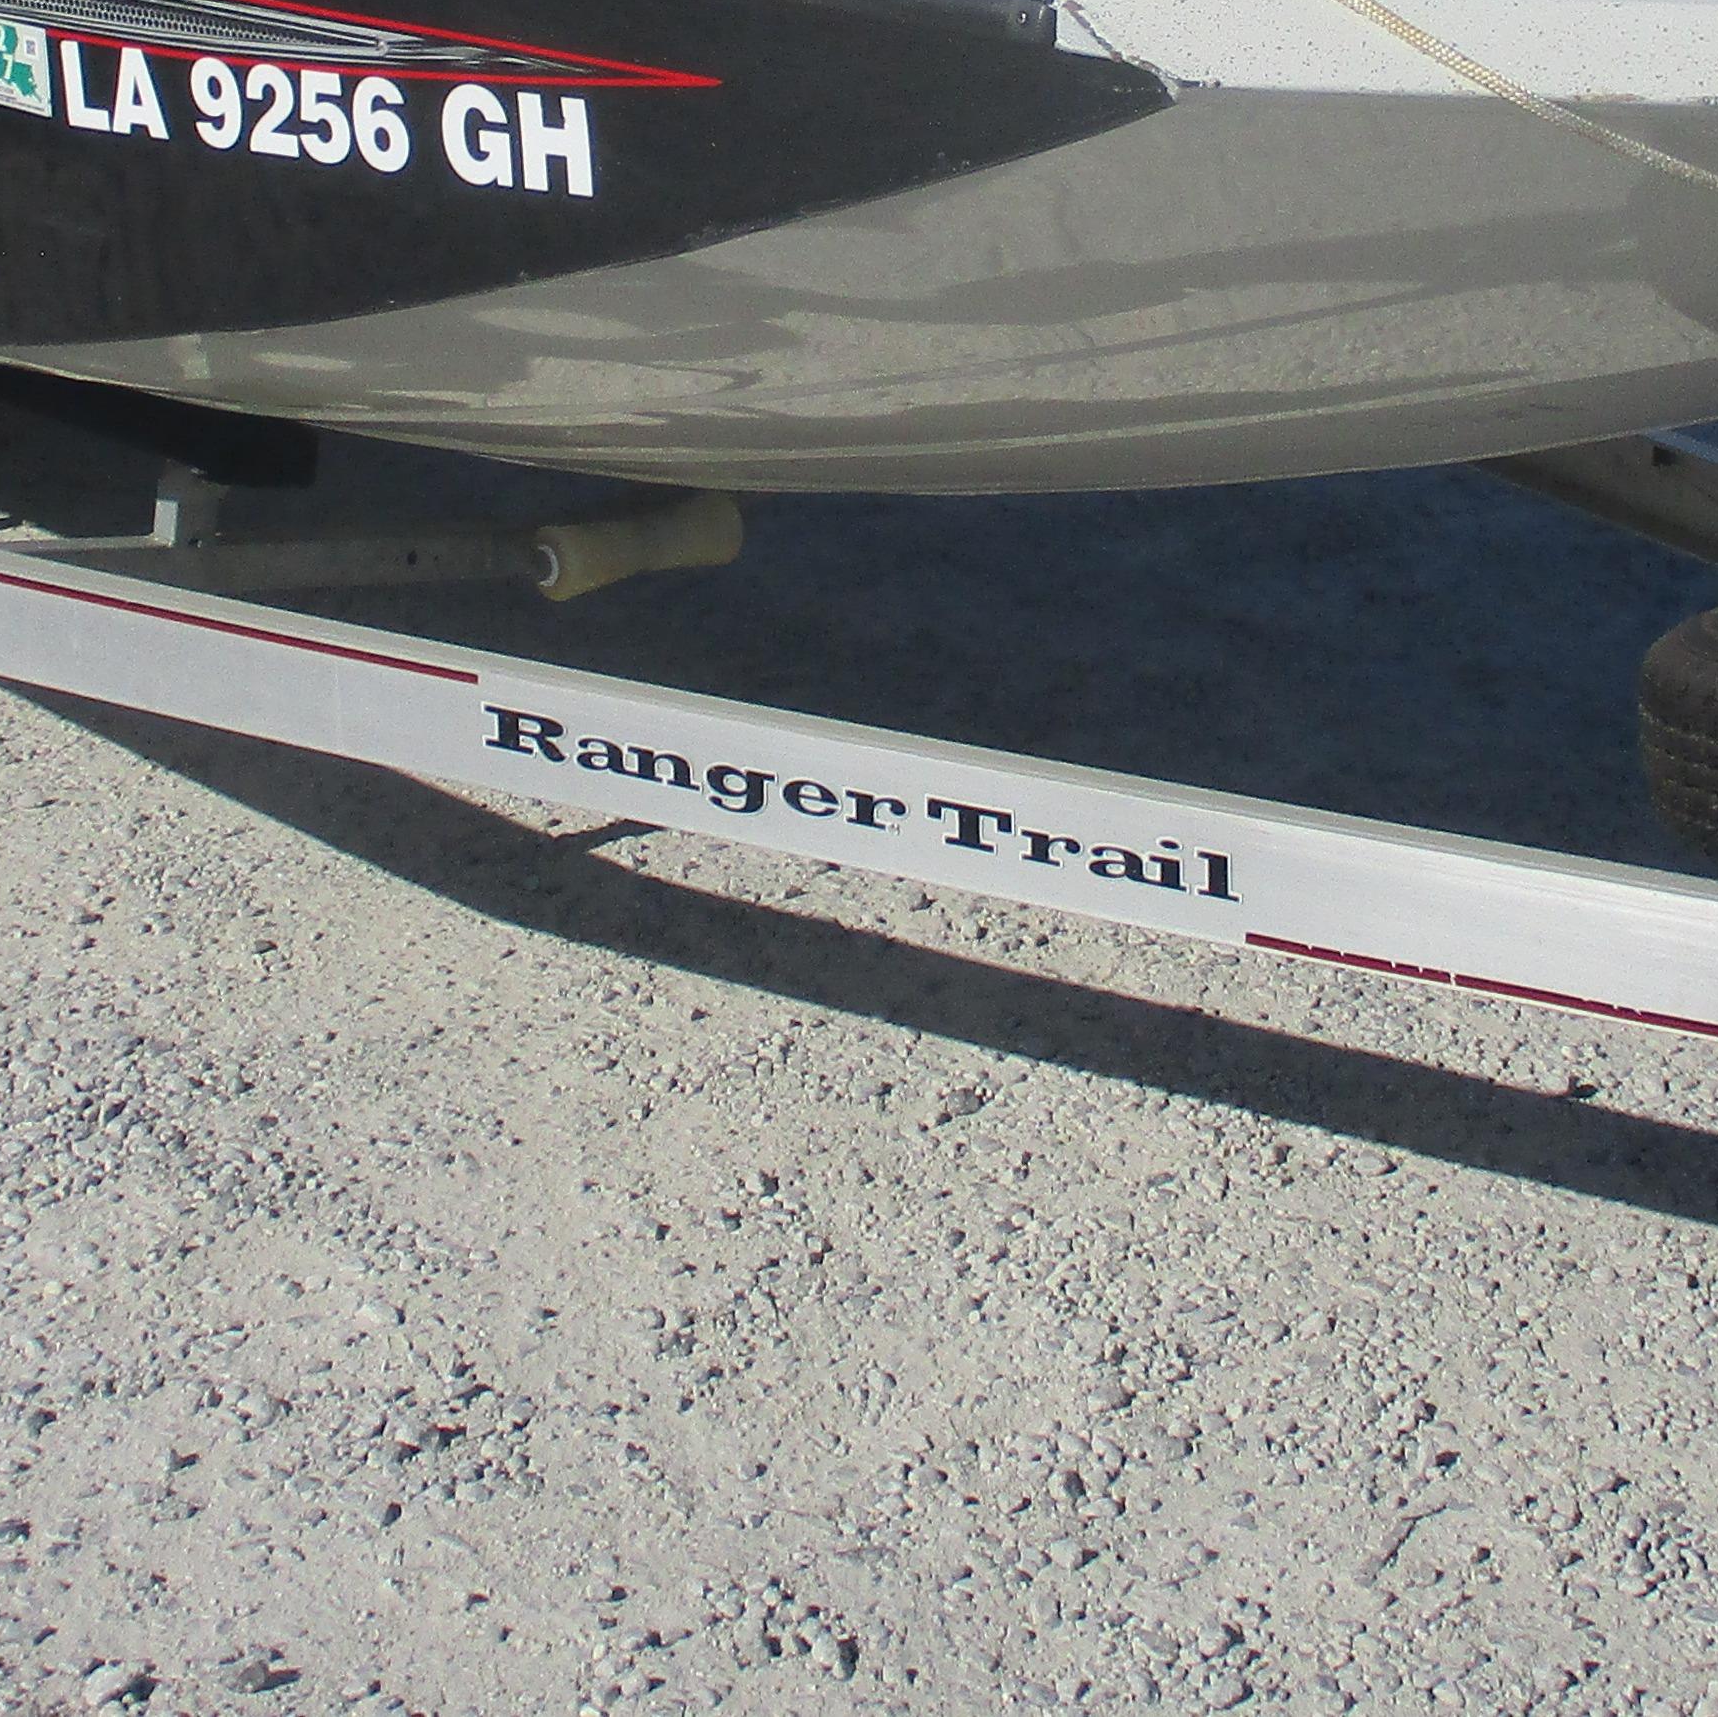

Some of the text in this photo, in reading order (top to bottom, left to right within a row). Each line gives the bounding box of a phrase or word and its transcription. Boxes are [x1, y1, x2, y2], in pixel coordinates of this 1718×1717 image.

[2, 54, 14, 80] 7
[59, 39, 595, 199] LA 9256 GH
[482, 703, 1243, 904] Ranger Trail
